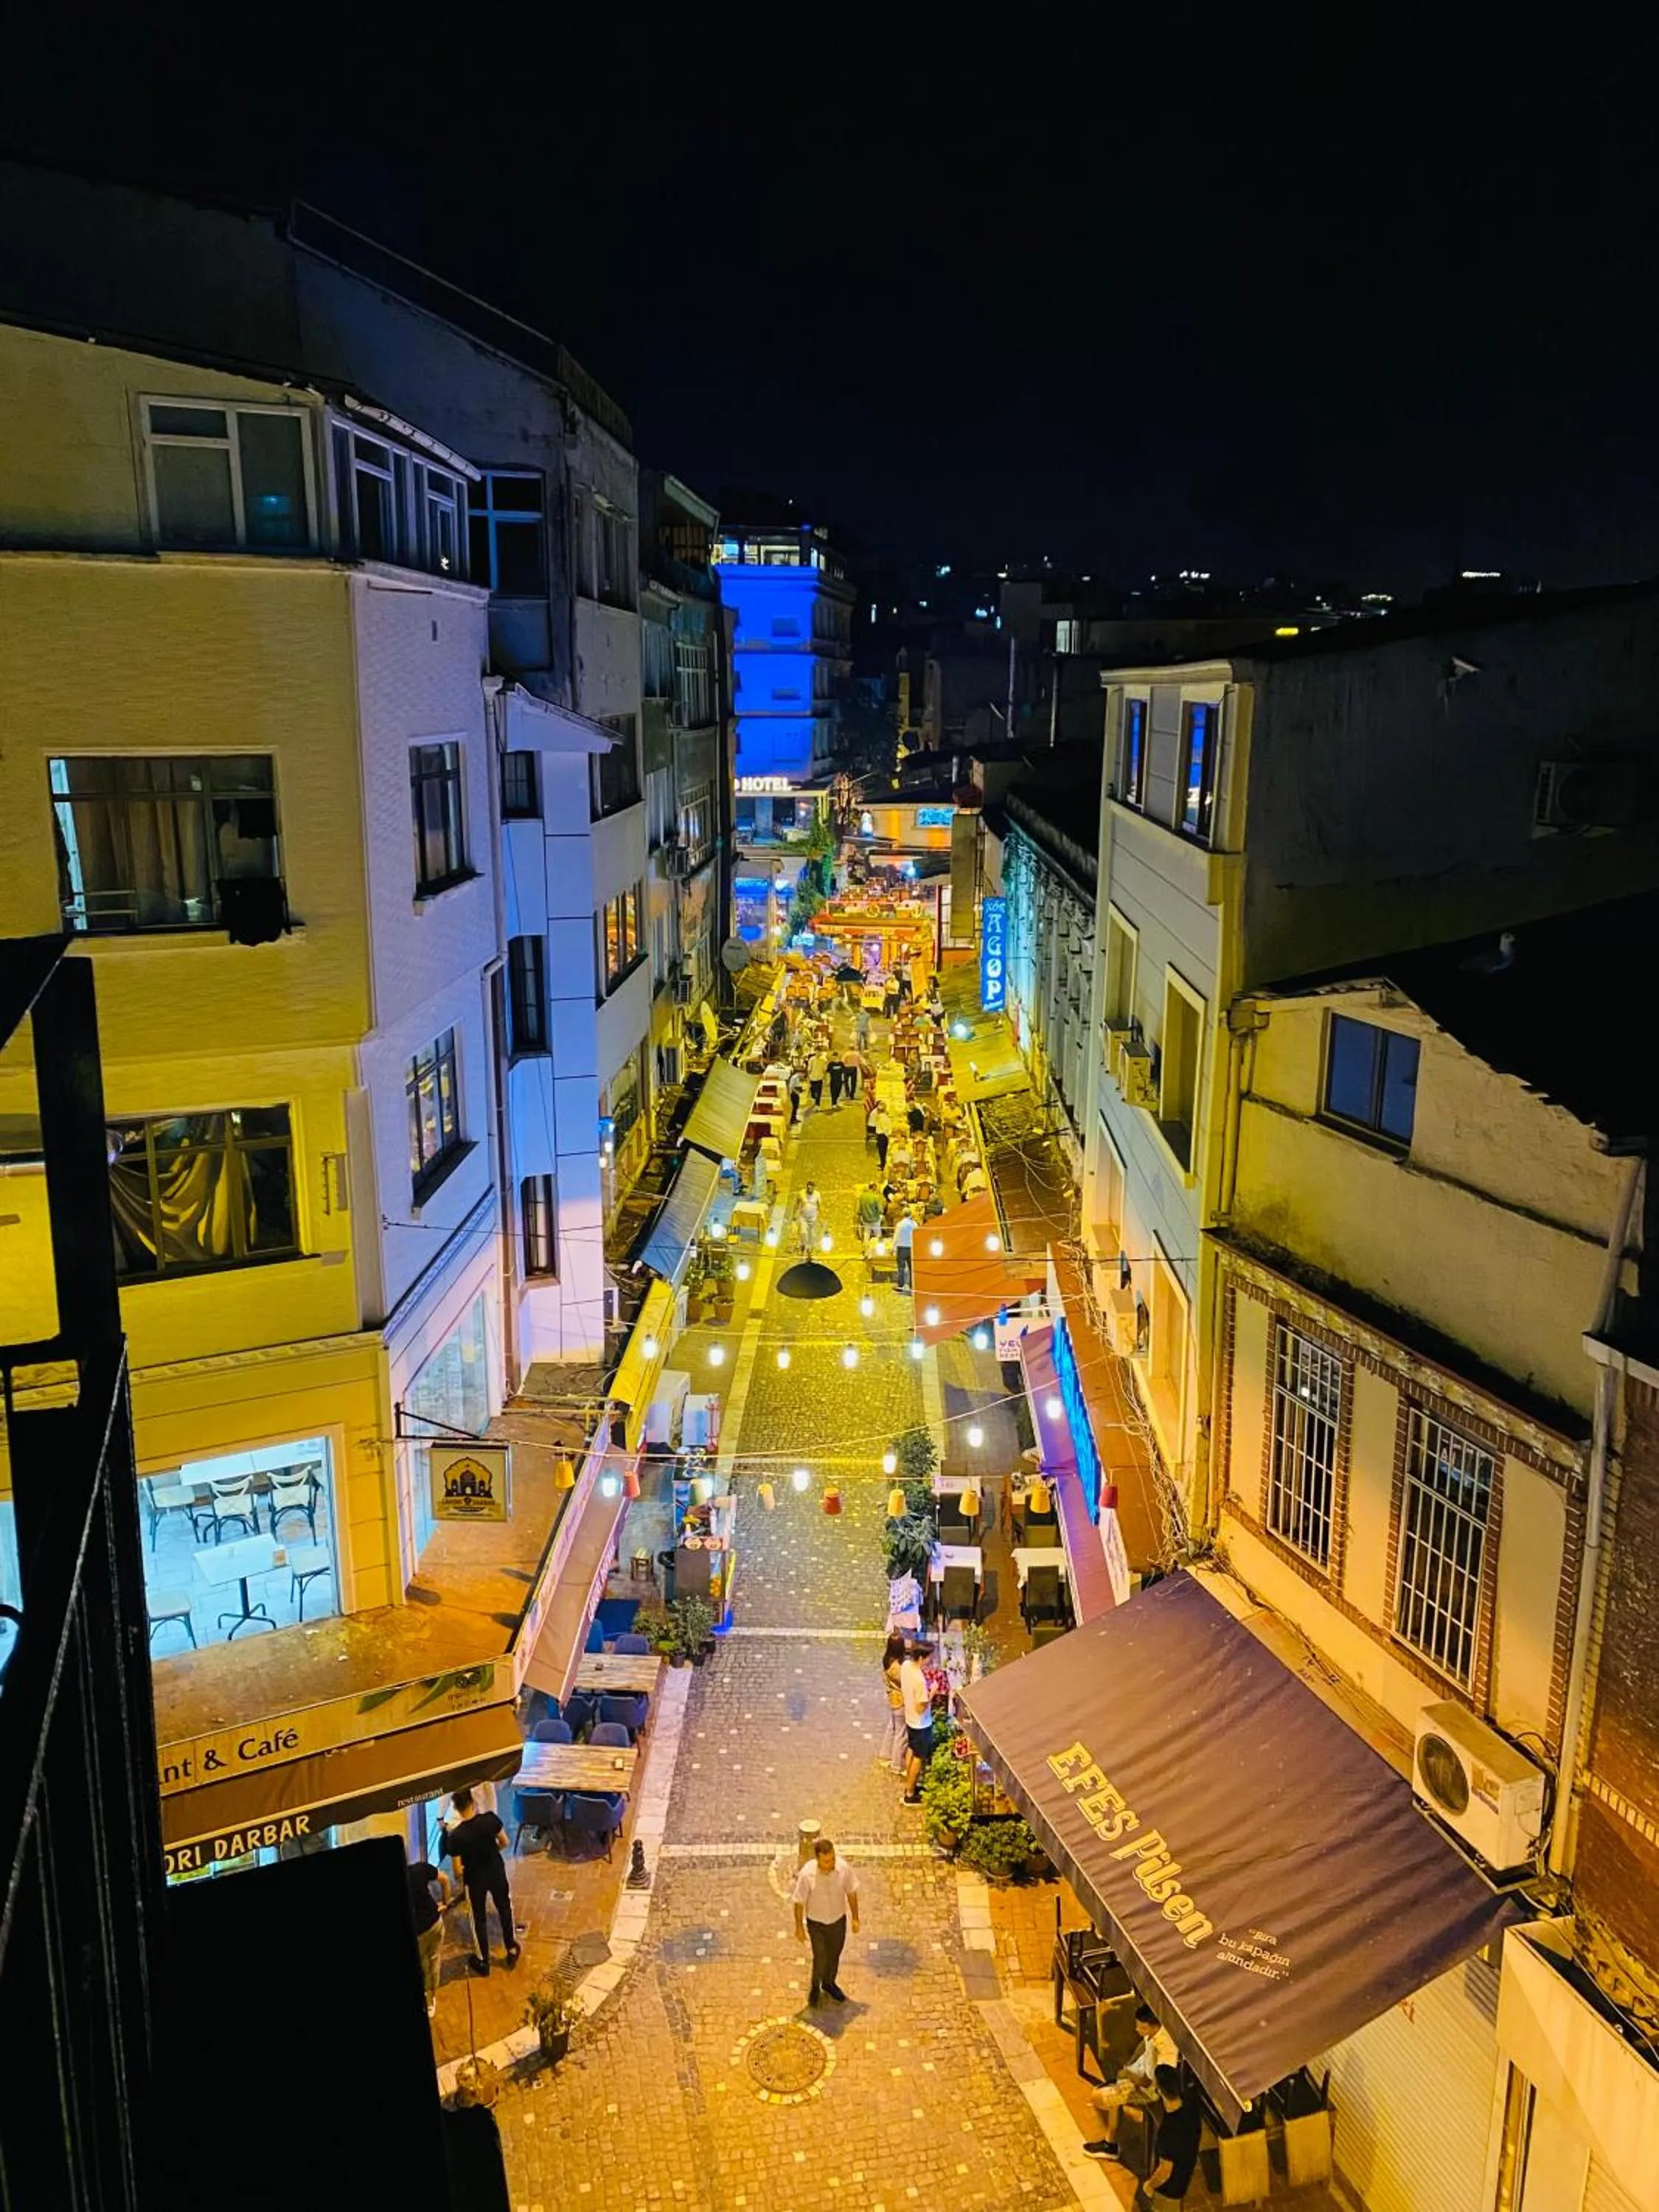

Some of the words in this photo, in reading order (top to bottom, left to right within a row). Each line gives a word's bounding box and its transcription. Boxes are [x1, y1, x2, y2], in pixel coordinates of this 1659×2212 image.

[741, 776, 792, 791] HOTEL
[987, 914, 1003, 1001] AGOP
[161, 1759, 192, 1784] nt
[204, 1749, 227, 1770] &
[238, 1728, 299, 1760] Café
[215, 1815, 310, 1859] DARBAR
[1046, 1742, 1140, 1841] EFES
[1109, 1829, 1213, 1949] Pilsen
[1218, 1933, 1237, 1948] bu
